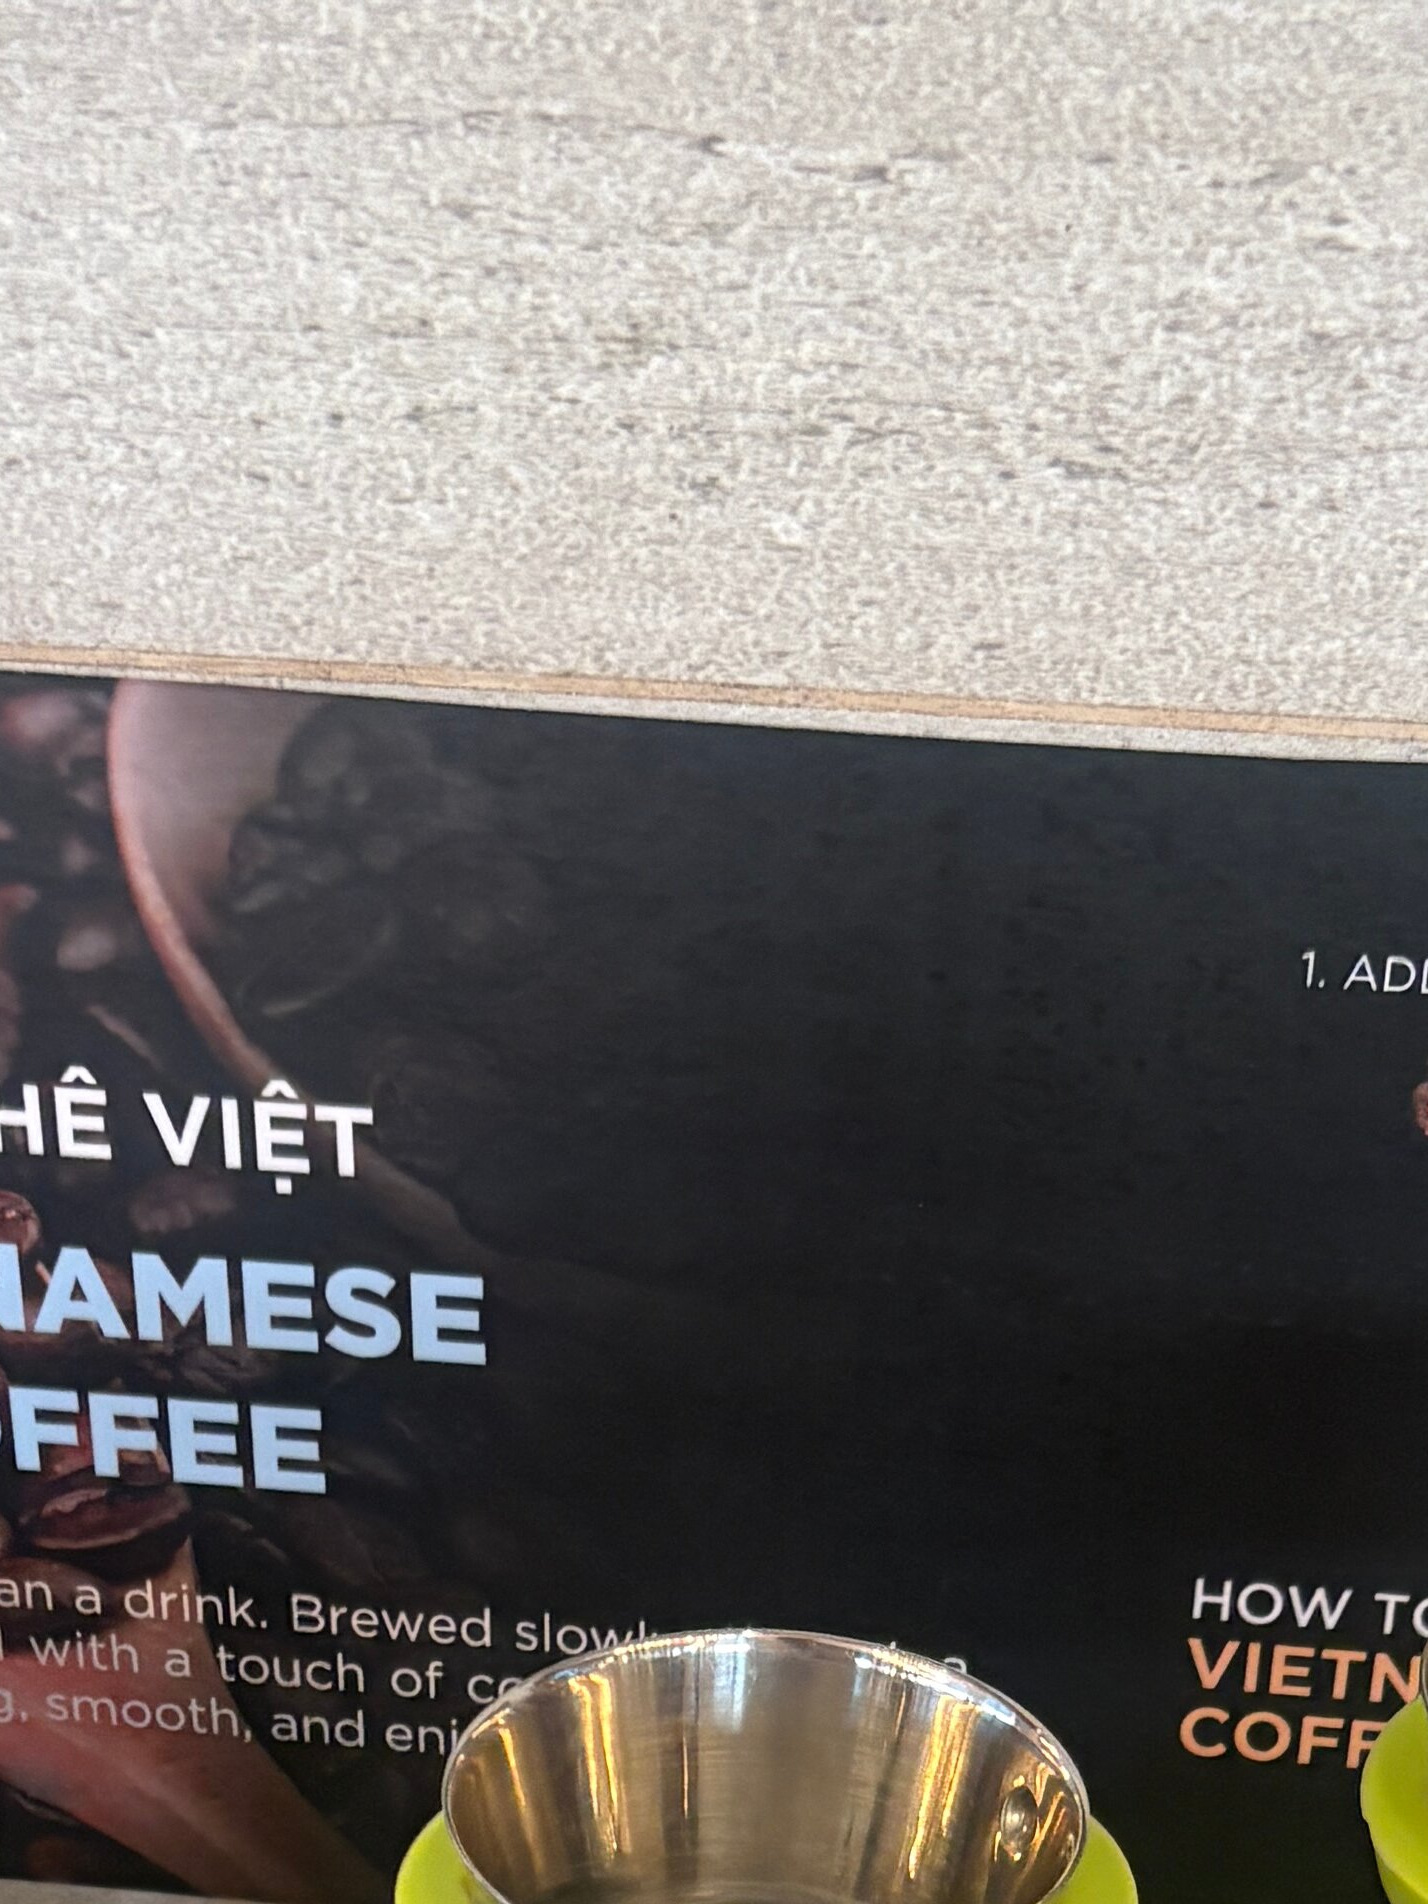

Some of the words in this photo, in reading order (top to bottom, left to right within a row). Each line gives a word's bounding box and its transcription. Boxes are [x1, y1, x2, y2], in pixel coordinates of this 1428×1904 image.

[1299, 950, 1326, 989] 1.
[143, 1078, 373, 1195] VIỆT
[74, 1583, 103, 1616] a
[124, 1577, 268, 1630] drink.
[291, 1594, 492, 1649] Brewed
[1191, 1576, 1354, 1631] HOW
[29, 1630, 139, 1675] with
[165, 1647, 192, 1678] a
[216, 1642, 366, 1694] touch
[390, 1660, 445, 1700] of
[1187, 1637, 1422, 1706] VIETN
[45, 1690, 253, 1741] smooth,
[271, 1708, 366, 1749] and
[1179, 1706, 1392, 1770] COFF
